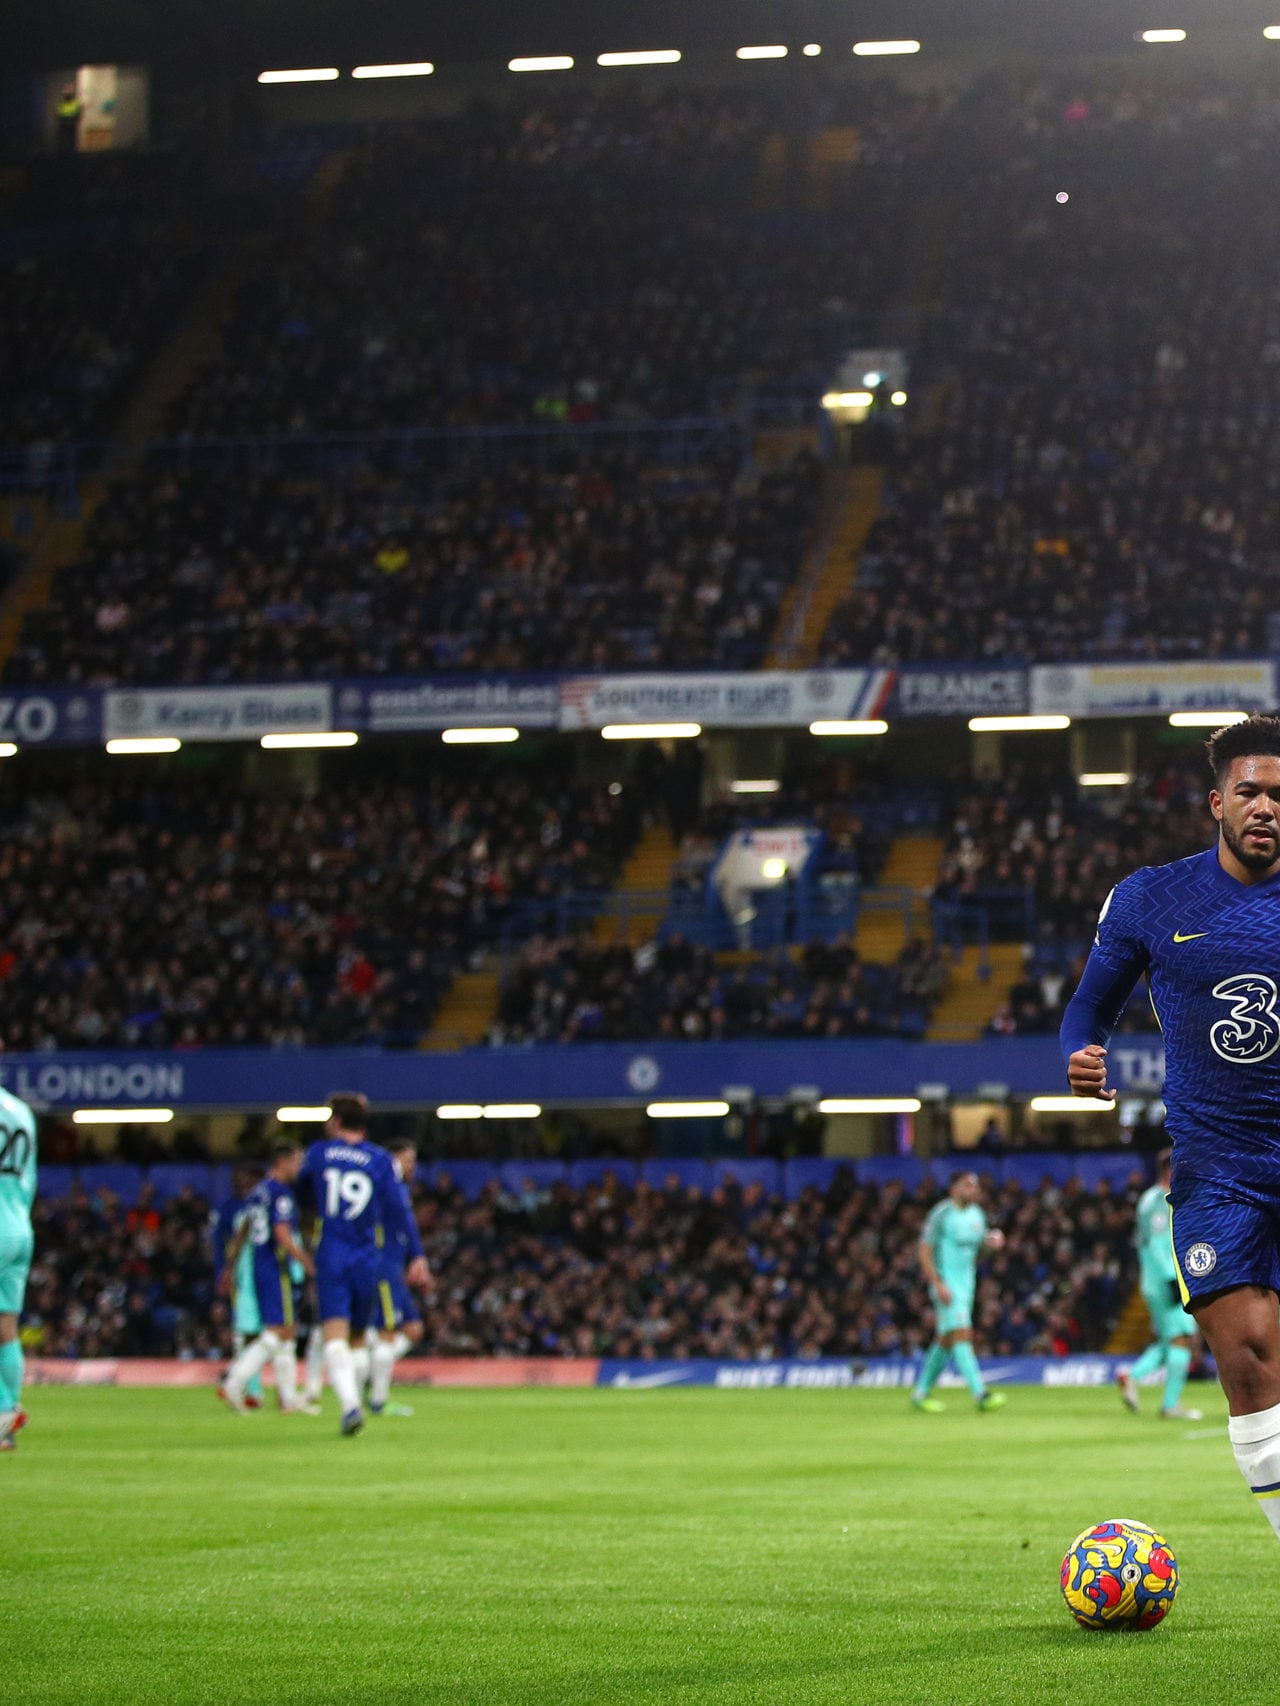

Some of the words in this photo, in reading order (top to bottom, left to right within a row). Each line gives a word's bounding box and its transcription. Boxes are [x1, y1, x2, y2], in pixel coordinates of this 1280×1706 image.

[902, 670, 1025, 700] FRANCE
[157, 704, 235, 730] Kerry
[241, 699, 322, 727] Blues
[16, 1063, 185, 1101] LONDON
[1114, 1048, 1167, 1087] TH
[323, 1166, 374, 1222] 19
